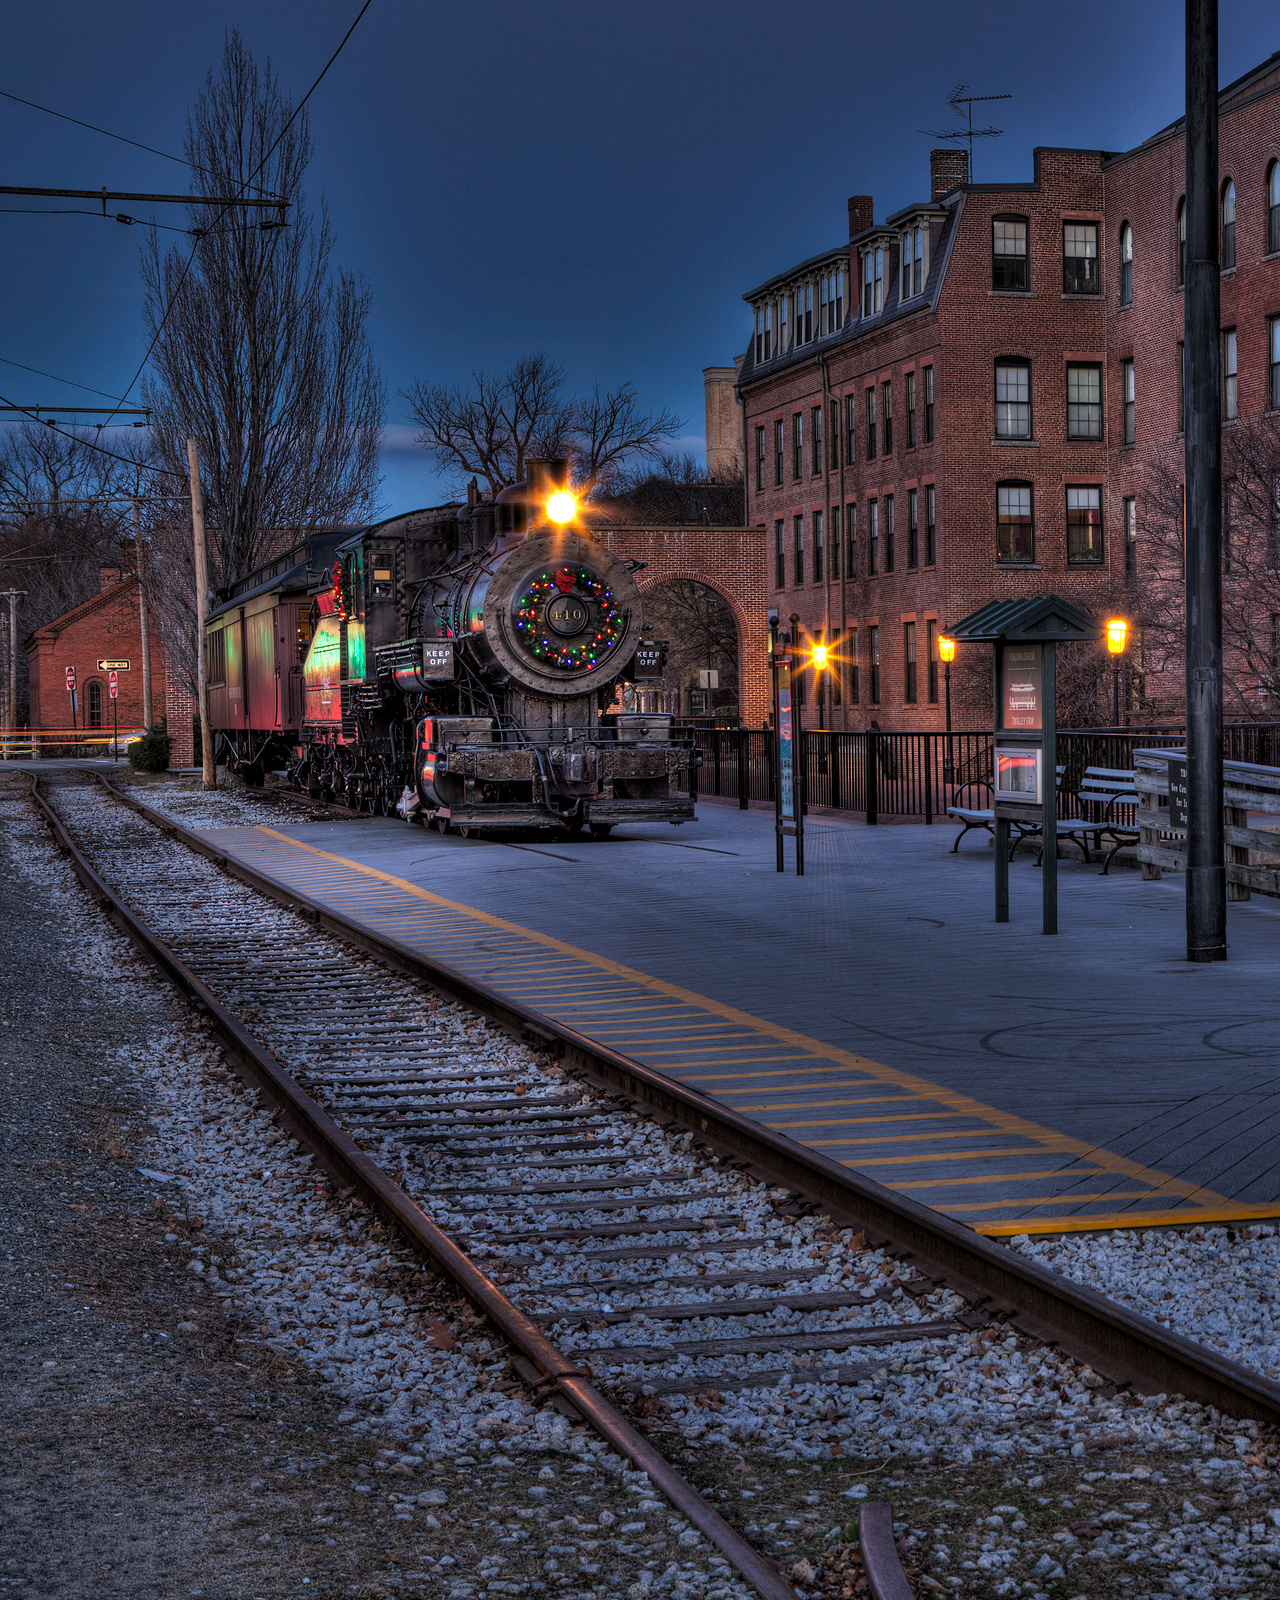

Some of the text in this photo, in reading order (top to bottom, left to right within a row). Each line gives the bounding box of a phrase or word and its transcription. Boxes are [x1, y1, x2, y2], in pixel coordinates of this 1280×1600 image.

[551, 609, 582, 620] 410
[1011, 716, 1035, 726] TROLLEY STOP
